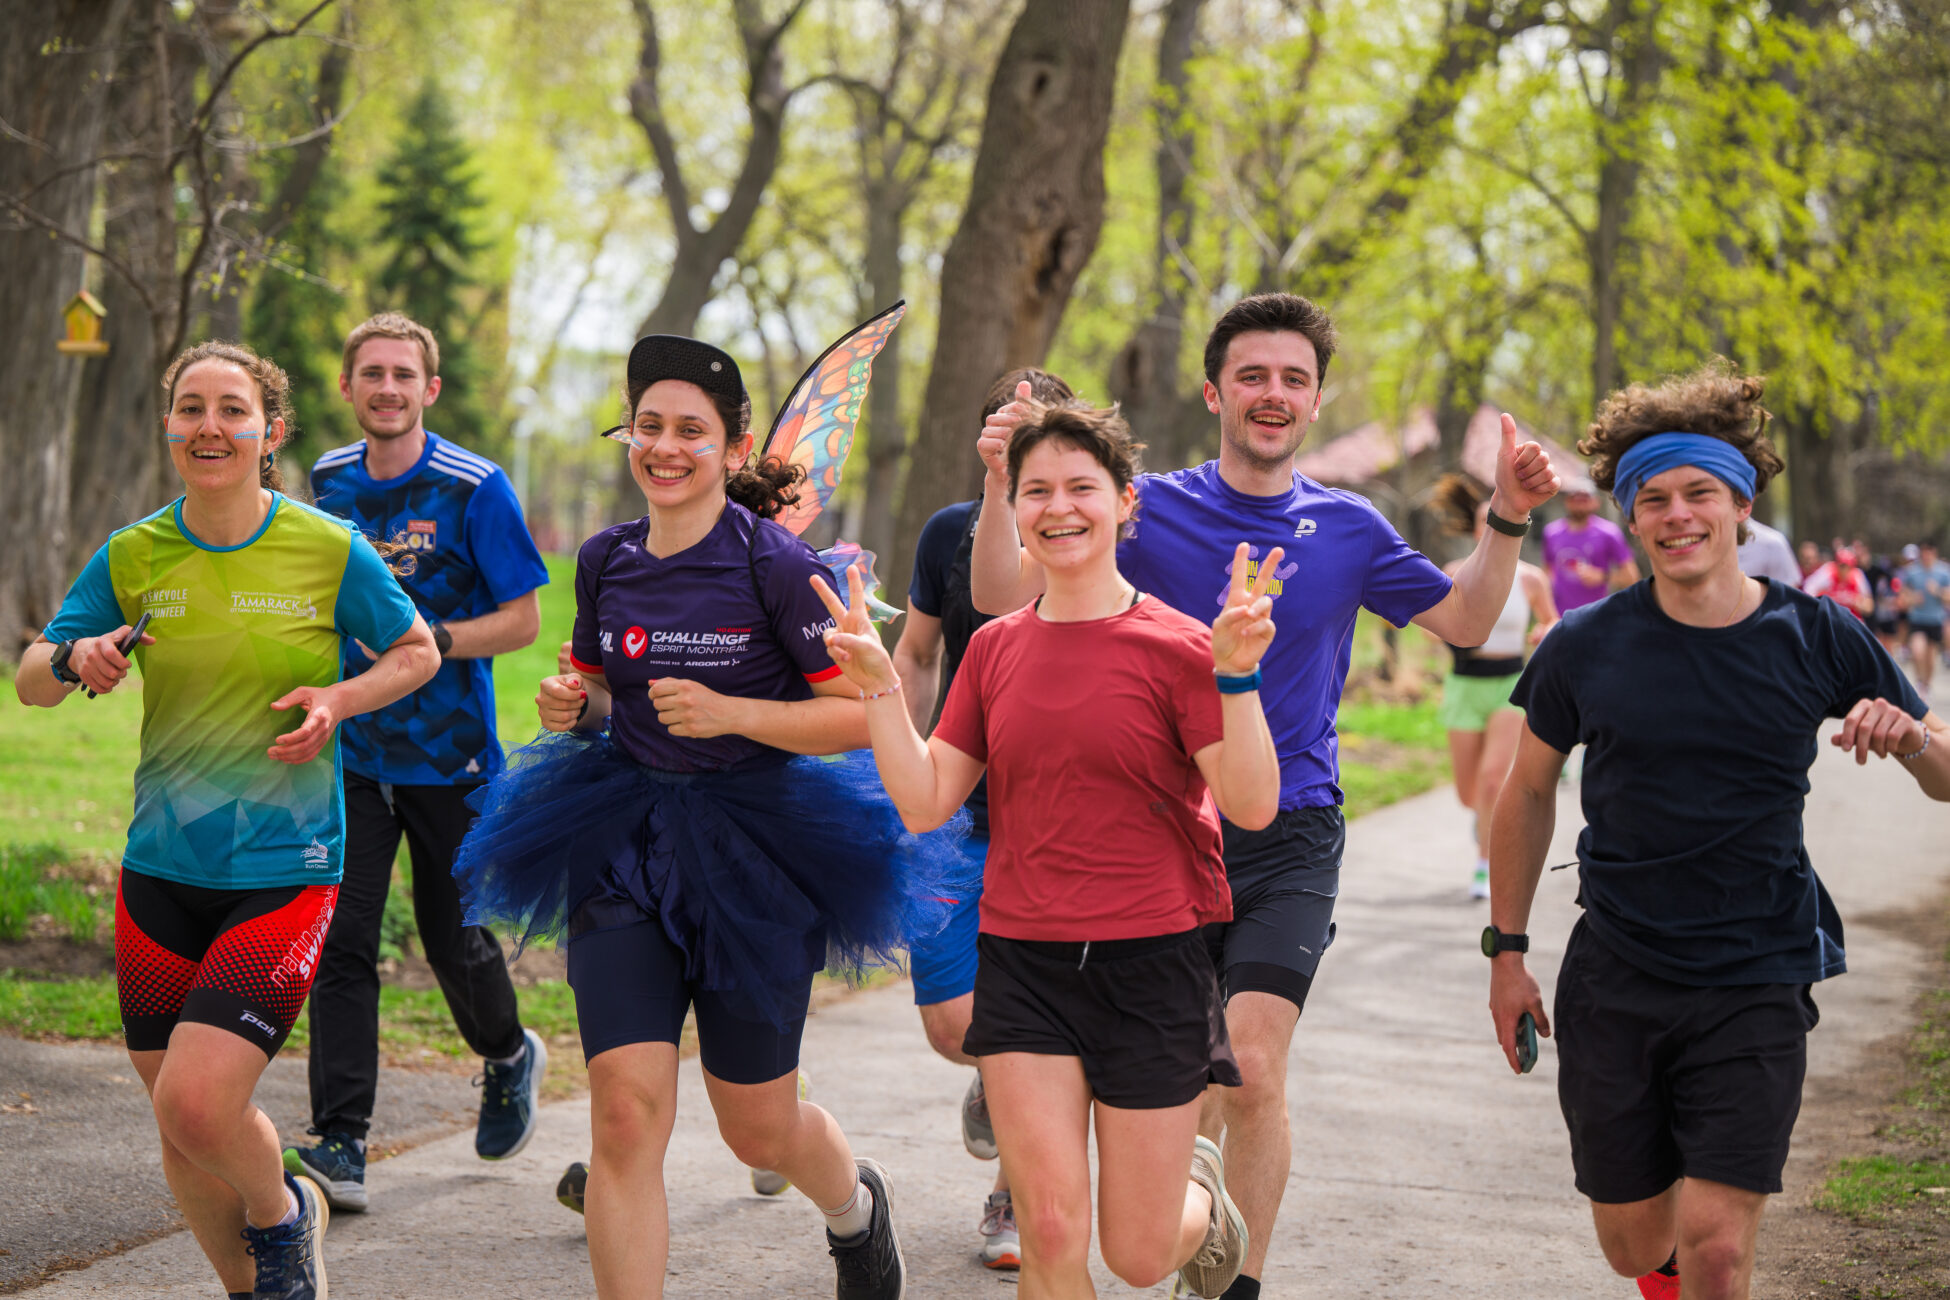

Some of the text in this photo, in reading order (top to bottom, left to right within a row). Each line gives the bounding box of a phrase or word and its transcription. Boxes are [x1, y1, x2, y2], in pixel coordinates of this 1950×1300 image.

[408, 533, 433, 550] OL
[231, 594, 301, 611] TAMARACK
[802, 616, 835, 640] Mon
[651, 631, 750, 645] CHALLENGE
[650, 644, 685, 653] ESPRIT
